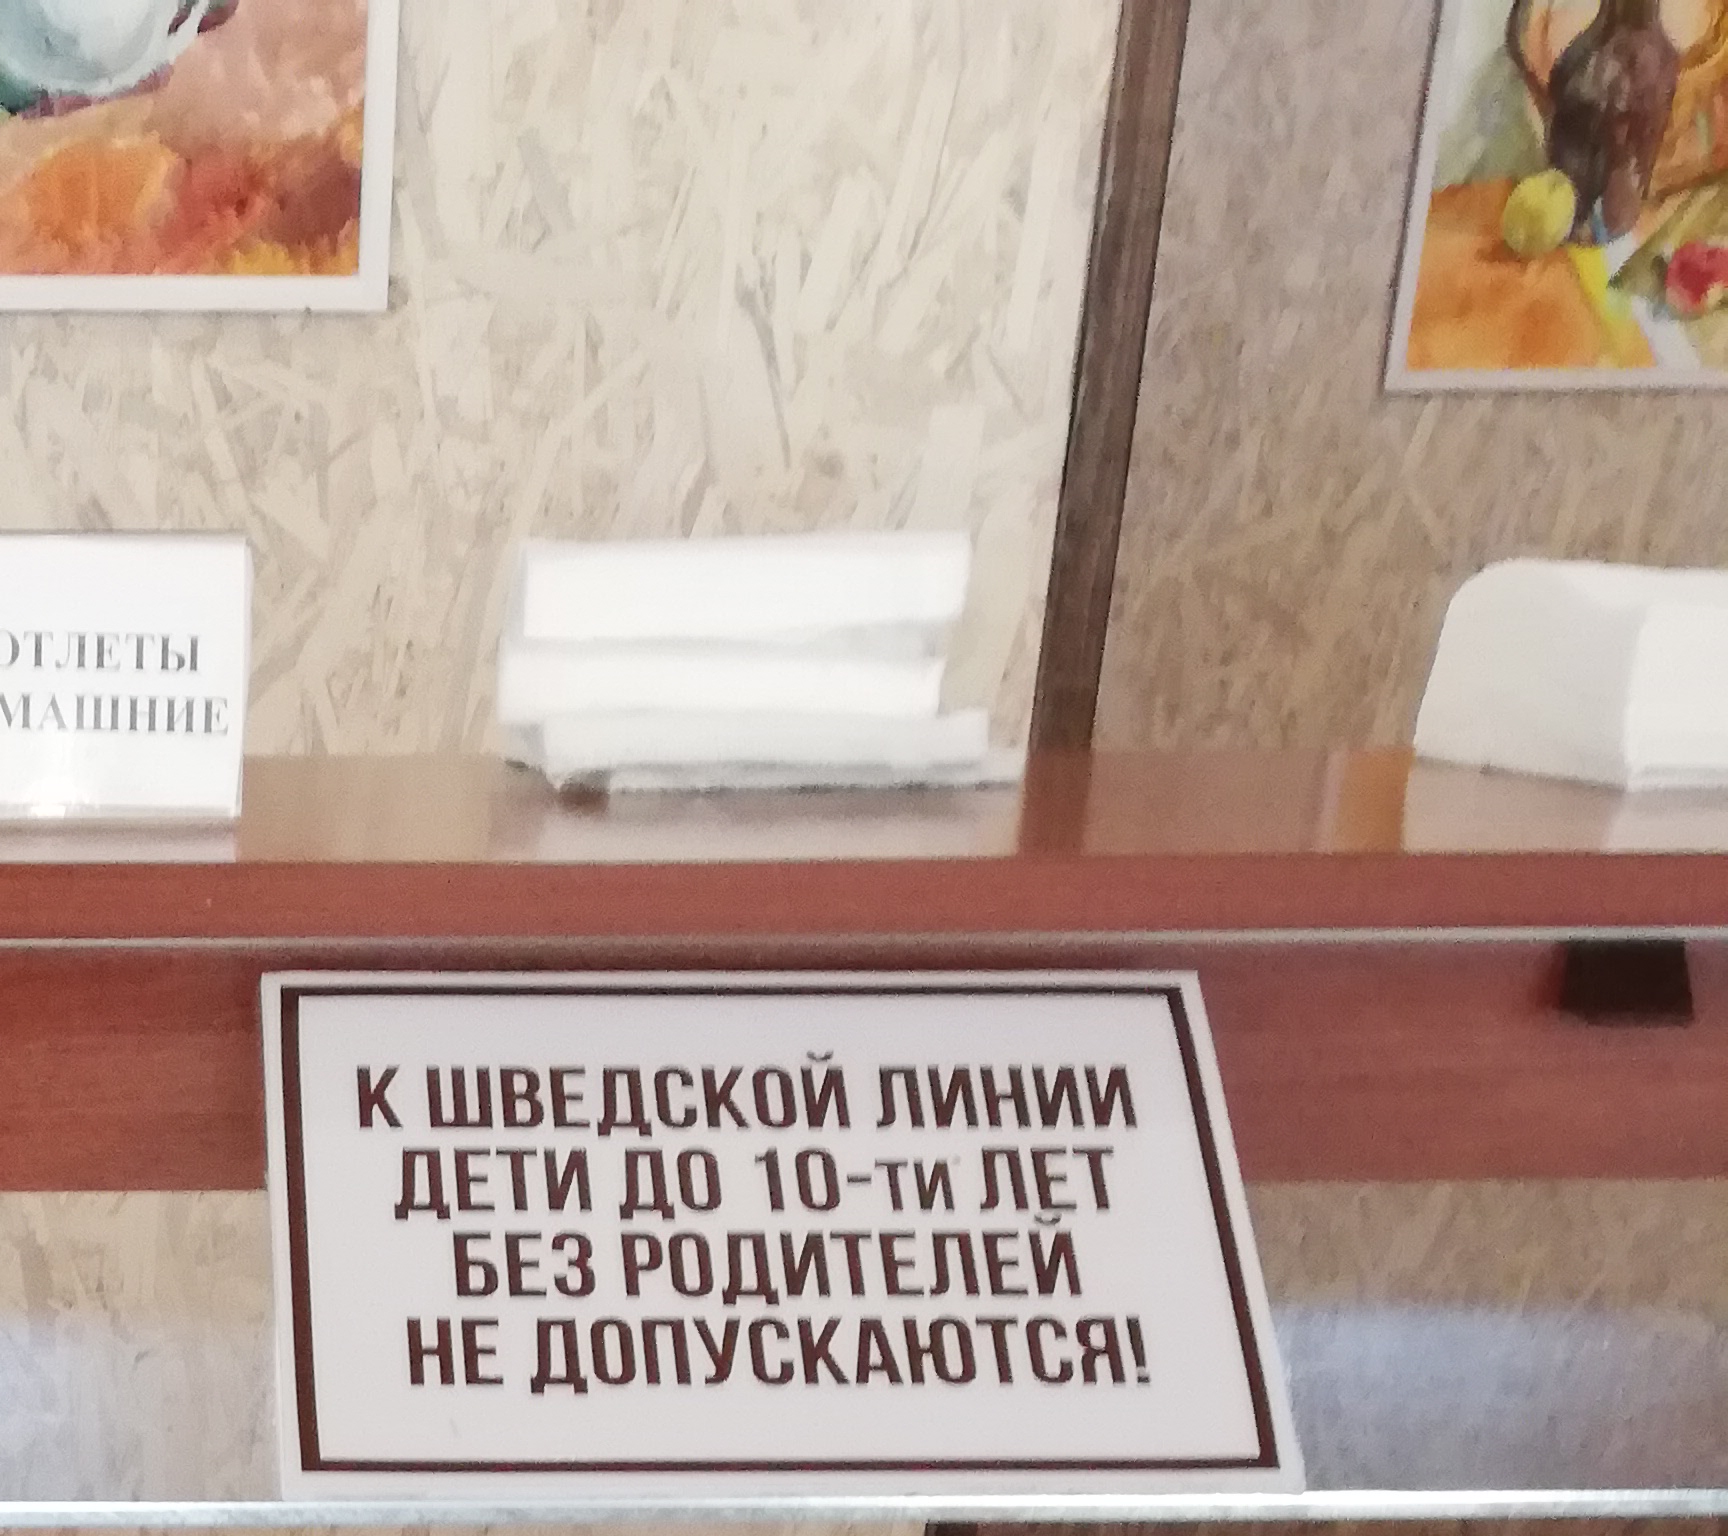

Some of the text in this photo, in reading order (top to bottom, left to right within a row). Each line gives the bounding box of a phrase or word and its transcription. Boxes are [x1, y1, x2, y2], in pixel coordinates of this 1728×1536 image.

[356, 1050, 1139, 1138] К ШВЕДСКОЙ ЛИНИИ
[393, 1147, 592, 1221] ДЕТИ
[618, 1147, 722, 1221] ДО
[977, 1145, 1116, 1212] ЛЕТ
[452, 1213, 1083, 1307] БЕЗ РОДИТЕЛЕЙ
[405, 1315, 1153, 1395] НЕ ДОПУСКАЮТСЯ!
